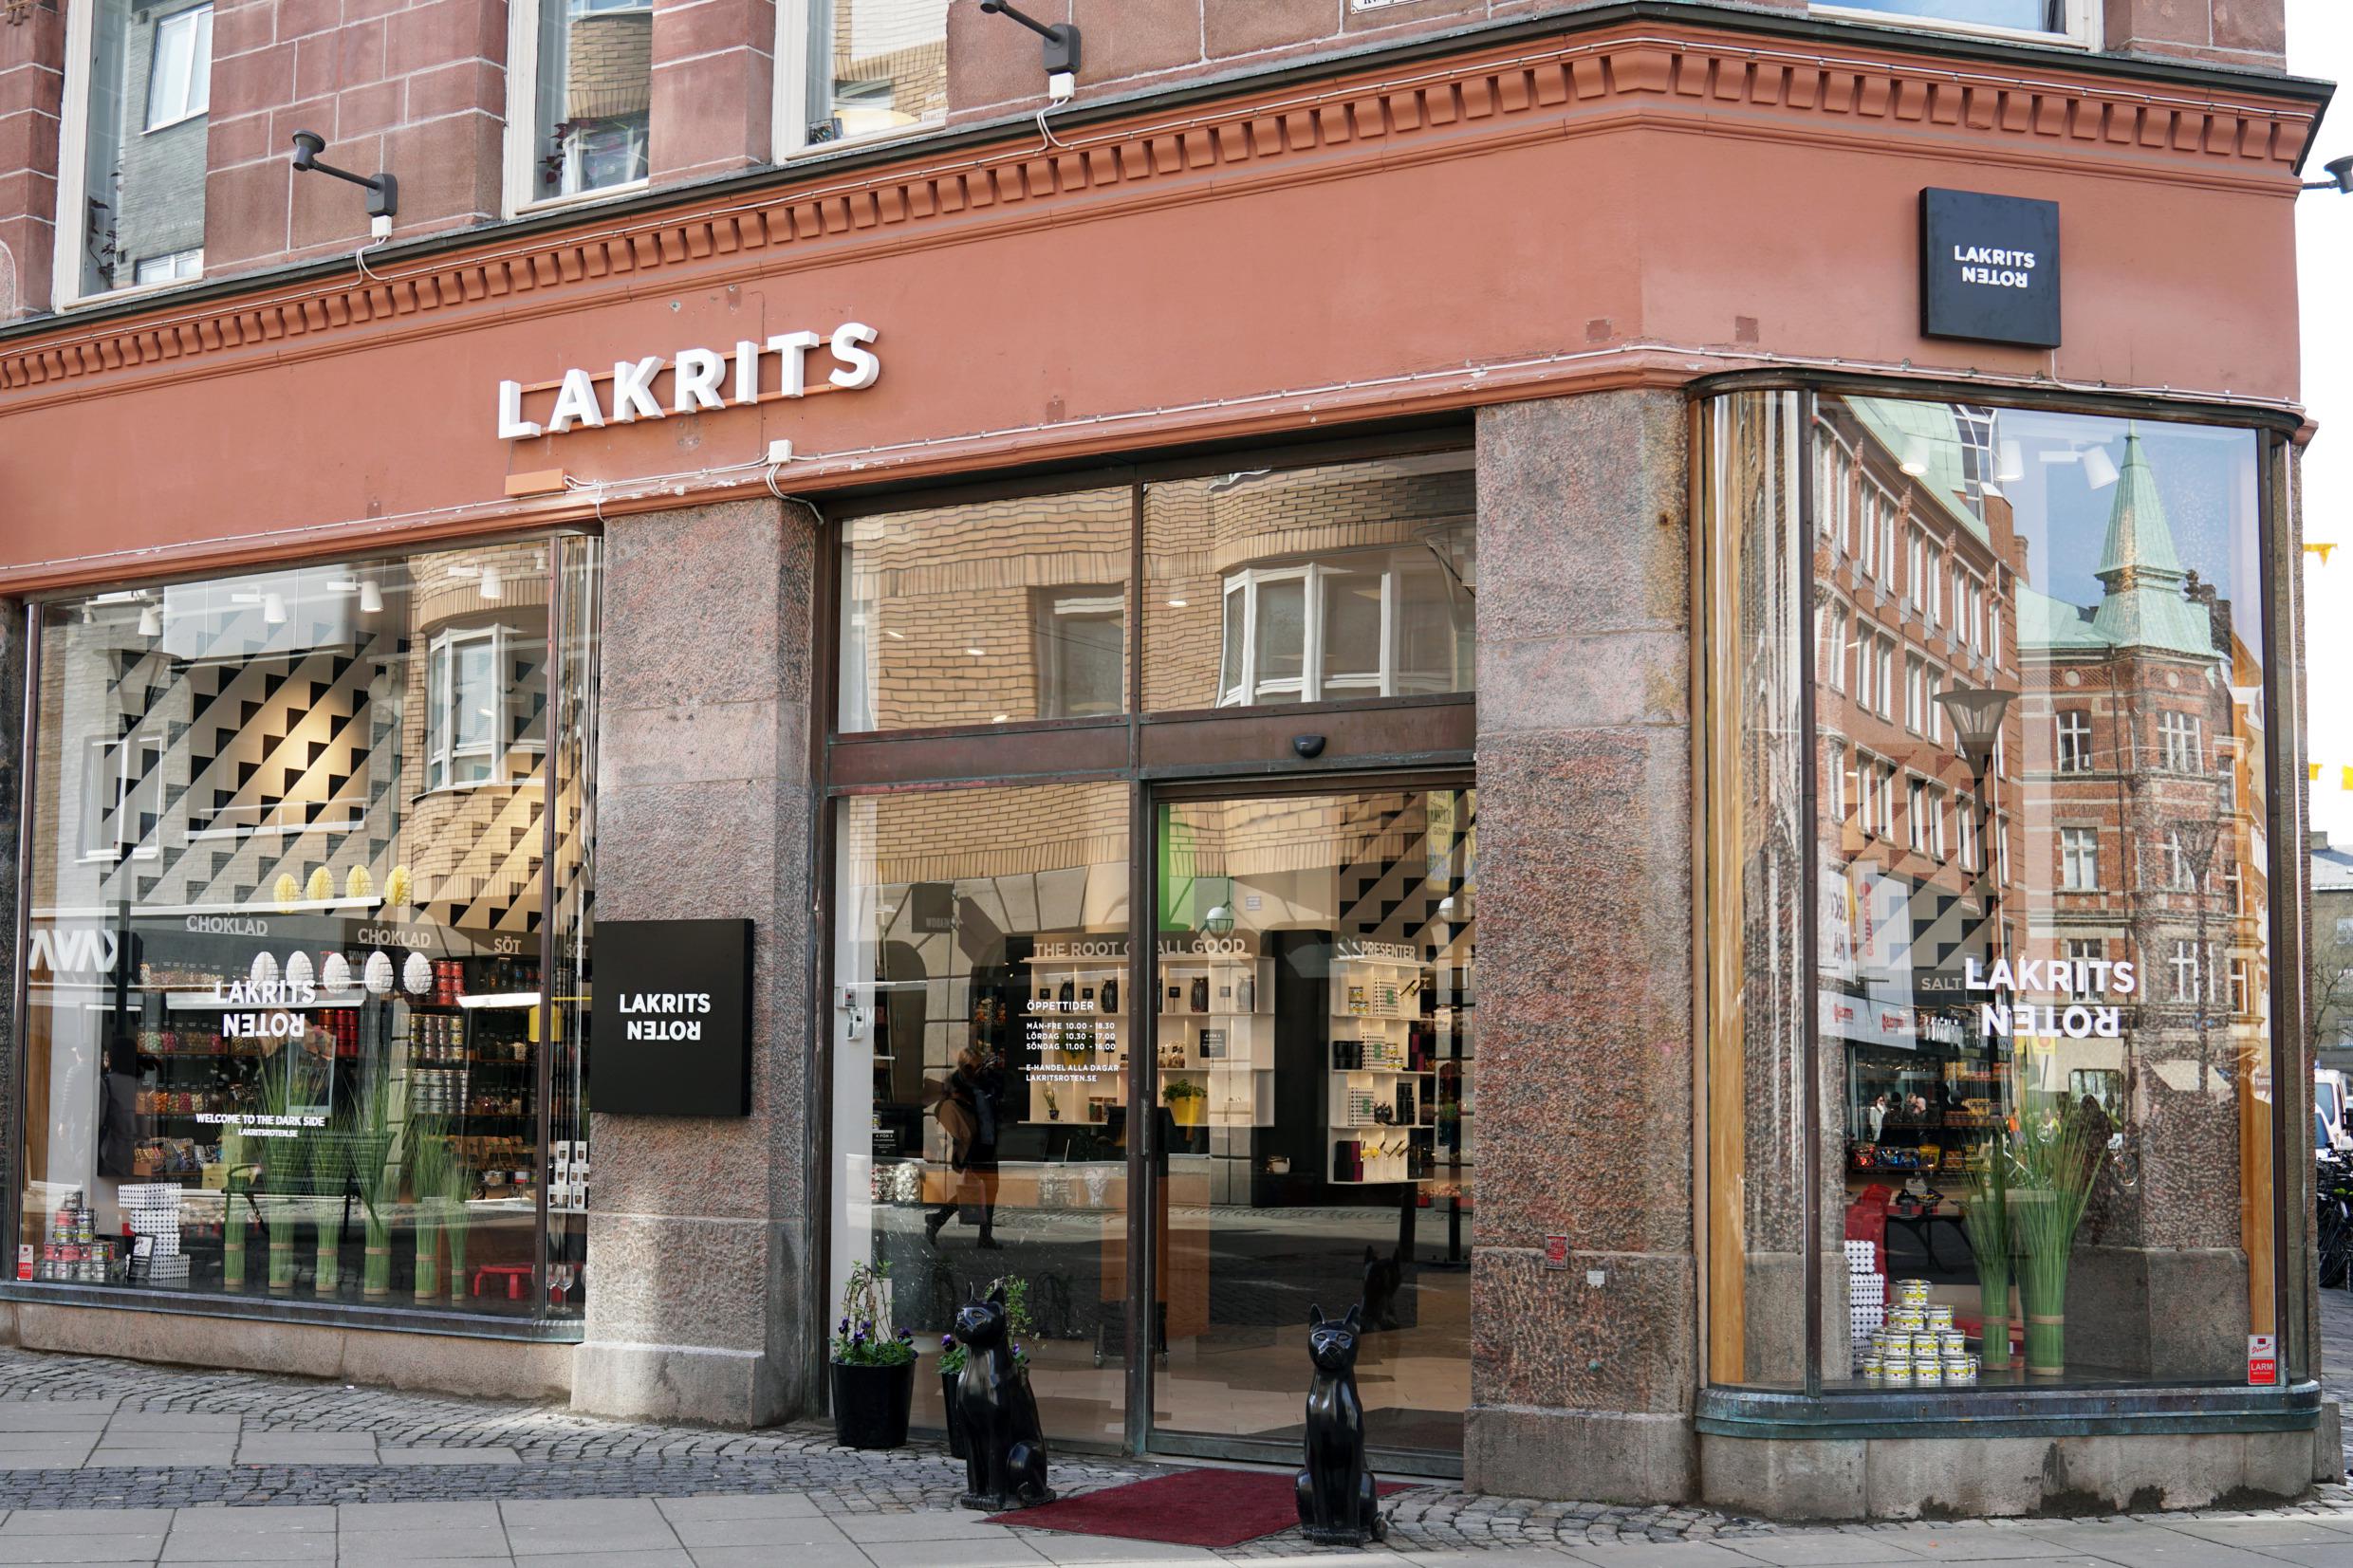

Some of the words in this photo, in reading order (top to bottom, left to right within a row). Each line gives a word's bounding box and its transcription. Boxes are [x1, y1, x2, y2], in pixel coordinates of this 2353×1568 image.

[1955, 245, 2035, 268] LAKRITS
[1962, 267, 2028, 288] ROTEN
[498, 322, 880, 440] LAKRITS
[186, 915, 269, 936] CHOKLAD
[358, 928, 431, 948] CHOKLAD
[494, 935, 521, 953] SÖT
[1033, 942, 1066, 957] THE
[1067, 941, 1119, 956] ROOT
[1192, 939, 1246, 954] GOOD
[1361, 940, 1416, 961] PRESENTER
[1921, 977, 1962, 990] SALT
[1965, 957, 2135, 993] LAKRITS
[214, 979, 316, 1005] LAKRITS
[619, 993, 711, 1013] LAKRITS
[1027, 1000, 1094, 1011] ÖPPETTIDER
[223, 1012, 306, 1038] ROTEN
[1026, 1021, 1063, 1030] MÅN-FRE
[1982, 1004, 2119, 1039] ROTEN
[627, 1021, 701, 1042] ROTEN
[1026, 1031, 1060, 1041] LÖRDAG
[1026, 1042, 1060, 1051] SÖNDAG
[1026, 1063, 1066, 1072] E-HANDEL
[1067, 1063, 1090, 1072] ALLA
[1090, 1064, 1120, 1073] DAGAR
[1026, 1074, 1098, 1083] LAKRITSROTEN.SE
[195, 1114, 241, 1124] WELCOME
[242, 1115, 255, 1125] TO
[255, 1115, 275, 1126] THE
[275, 1116, 302, 1126] DARK
[303, 1116, 325, 1127] SIDE
[238, 1128, 299, 1138] LAKRITSROTEN.SE
[2251, 1362, 2273, 1371] LARM
